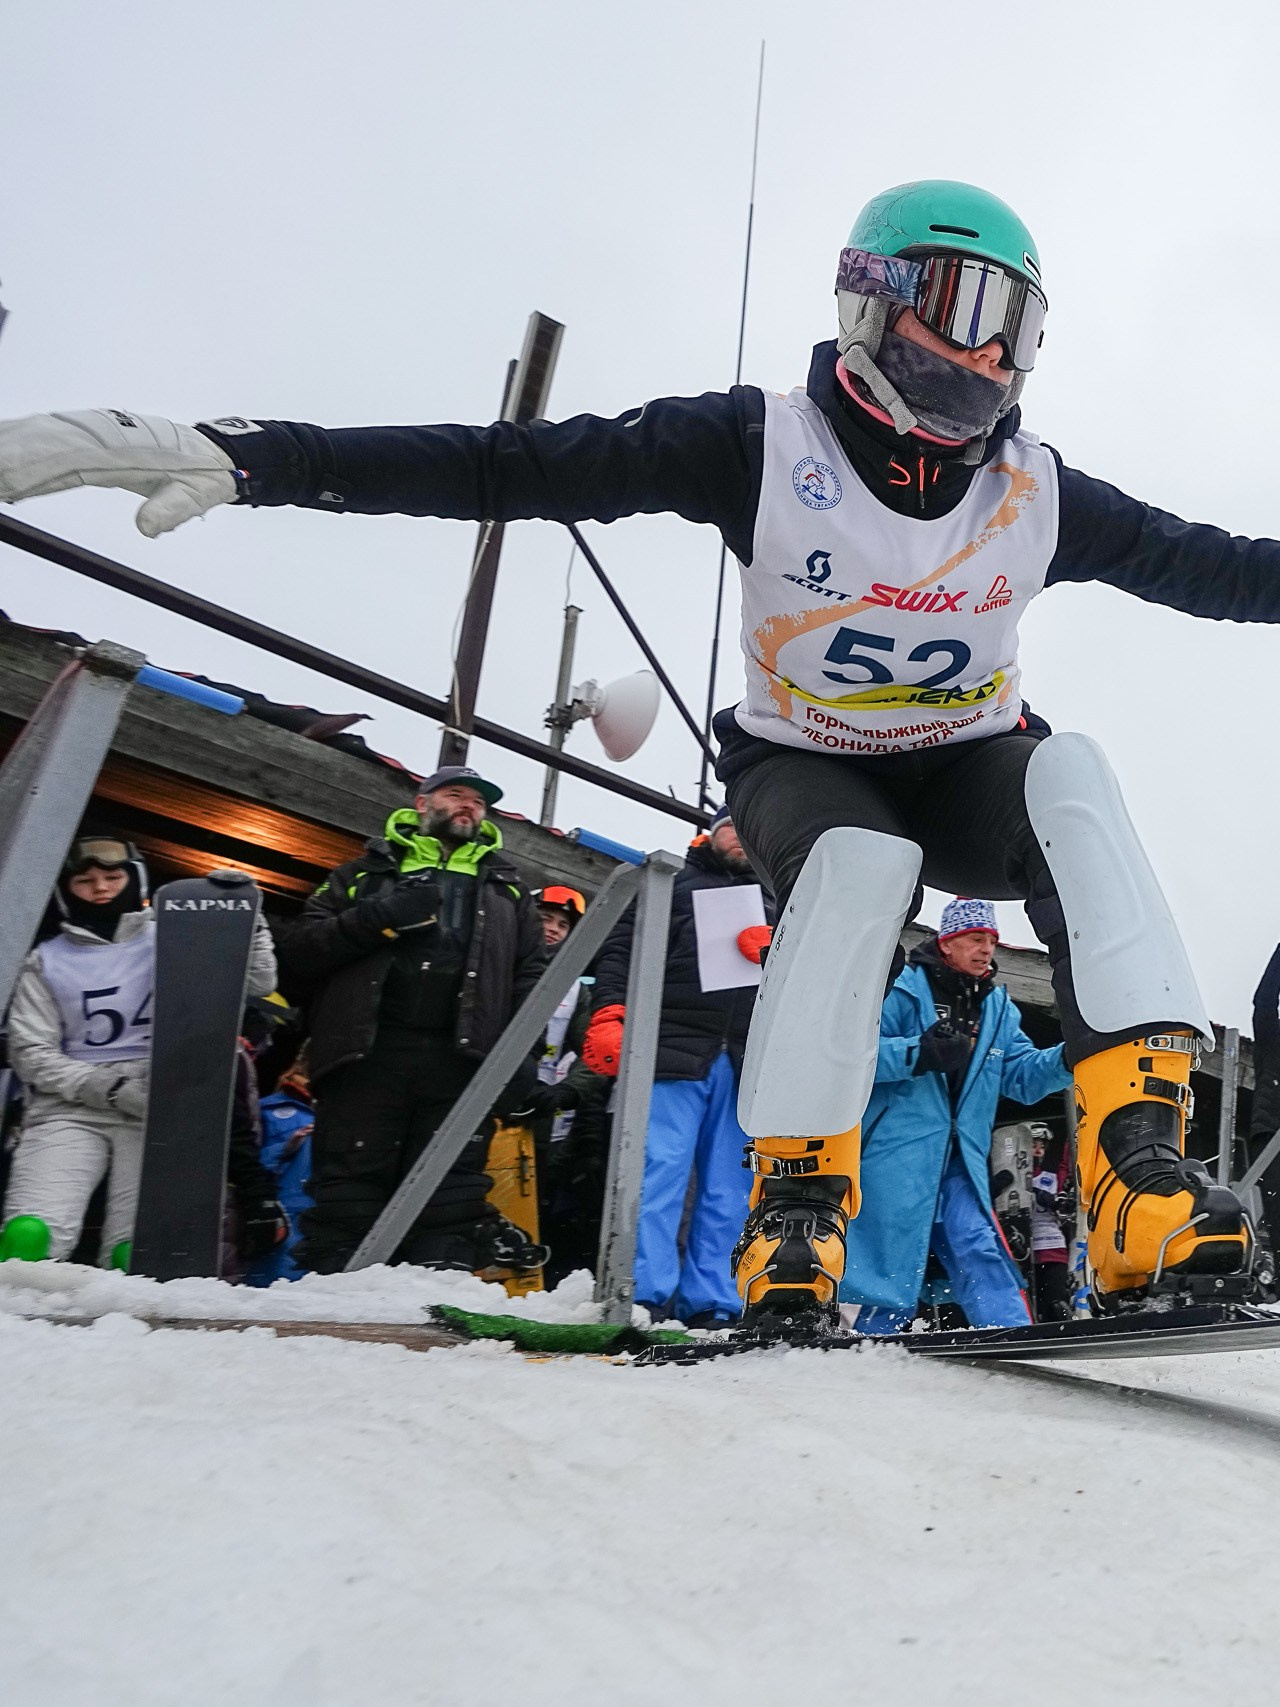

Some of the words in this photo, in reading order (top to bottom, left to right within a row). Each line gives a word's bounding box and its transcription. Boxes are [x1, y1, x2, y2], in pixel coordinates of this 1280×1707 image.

[781, 573, 852, 600] SCOTT
[821, 626, 971, 691] 52
[908, 729, 955, 749] ТЯГА
